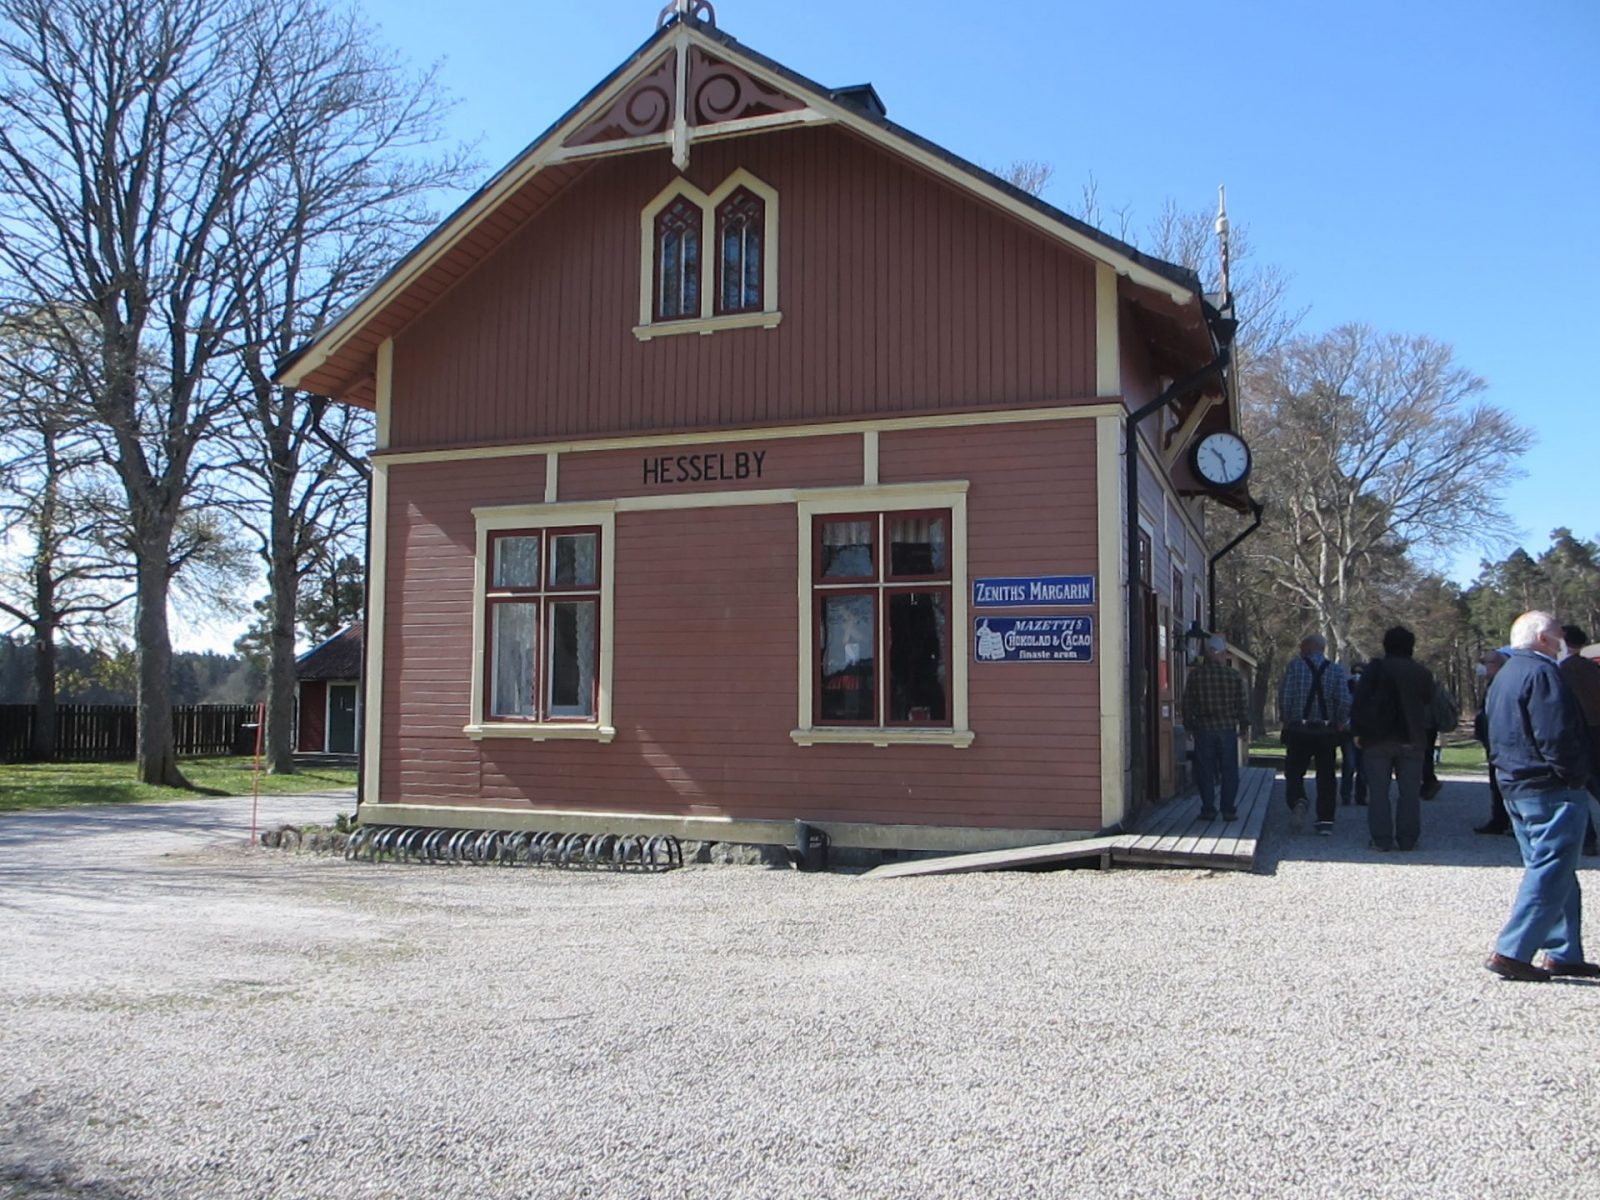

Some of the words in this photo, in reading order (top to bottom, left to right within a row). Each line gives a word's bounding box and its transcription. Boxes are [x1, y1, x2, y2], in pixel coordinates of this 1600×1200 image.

[643, 450, 766, 484] HESSELBY
[976, 583, 1025, 602] ZENITHS
[1030, 582, 1090, 600] MARGARIN
[1004, 630, 1051, 651] CHOKOLAD
[1053, 635, 1060, 646] &
[1061, 630, 1091, 651] CACAO
